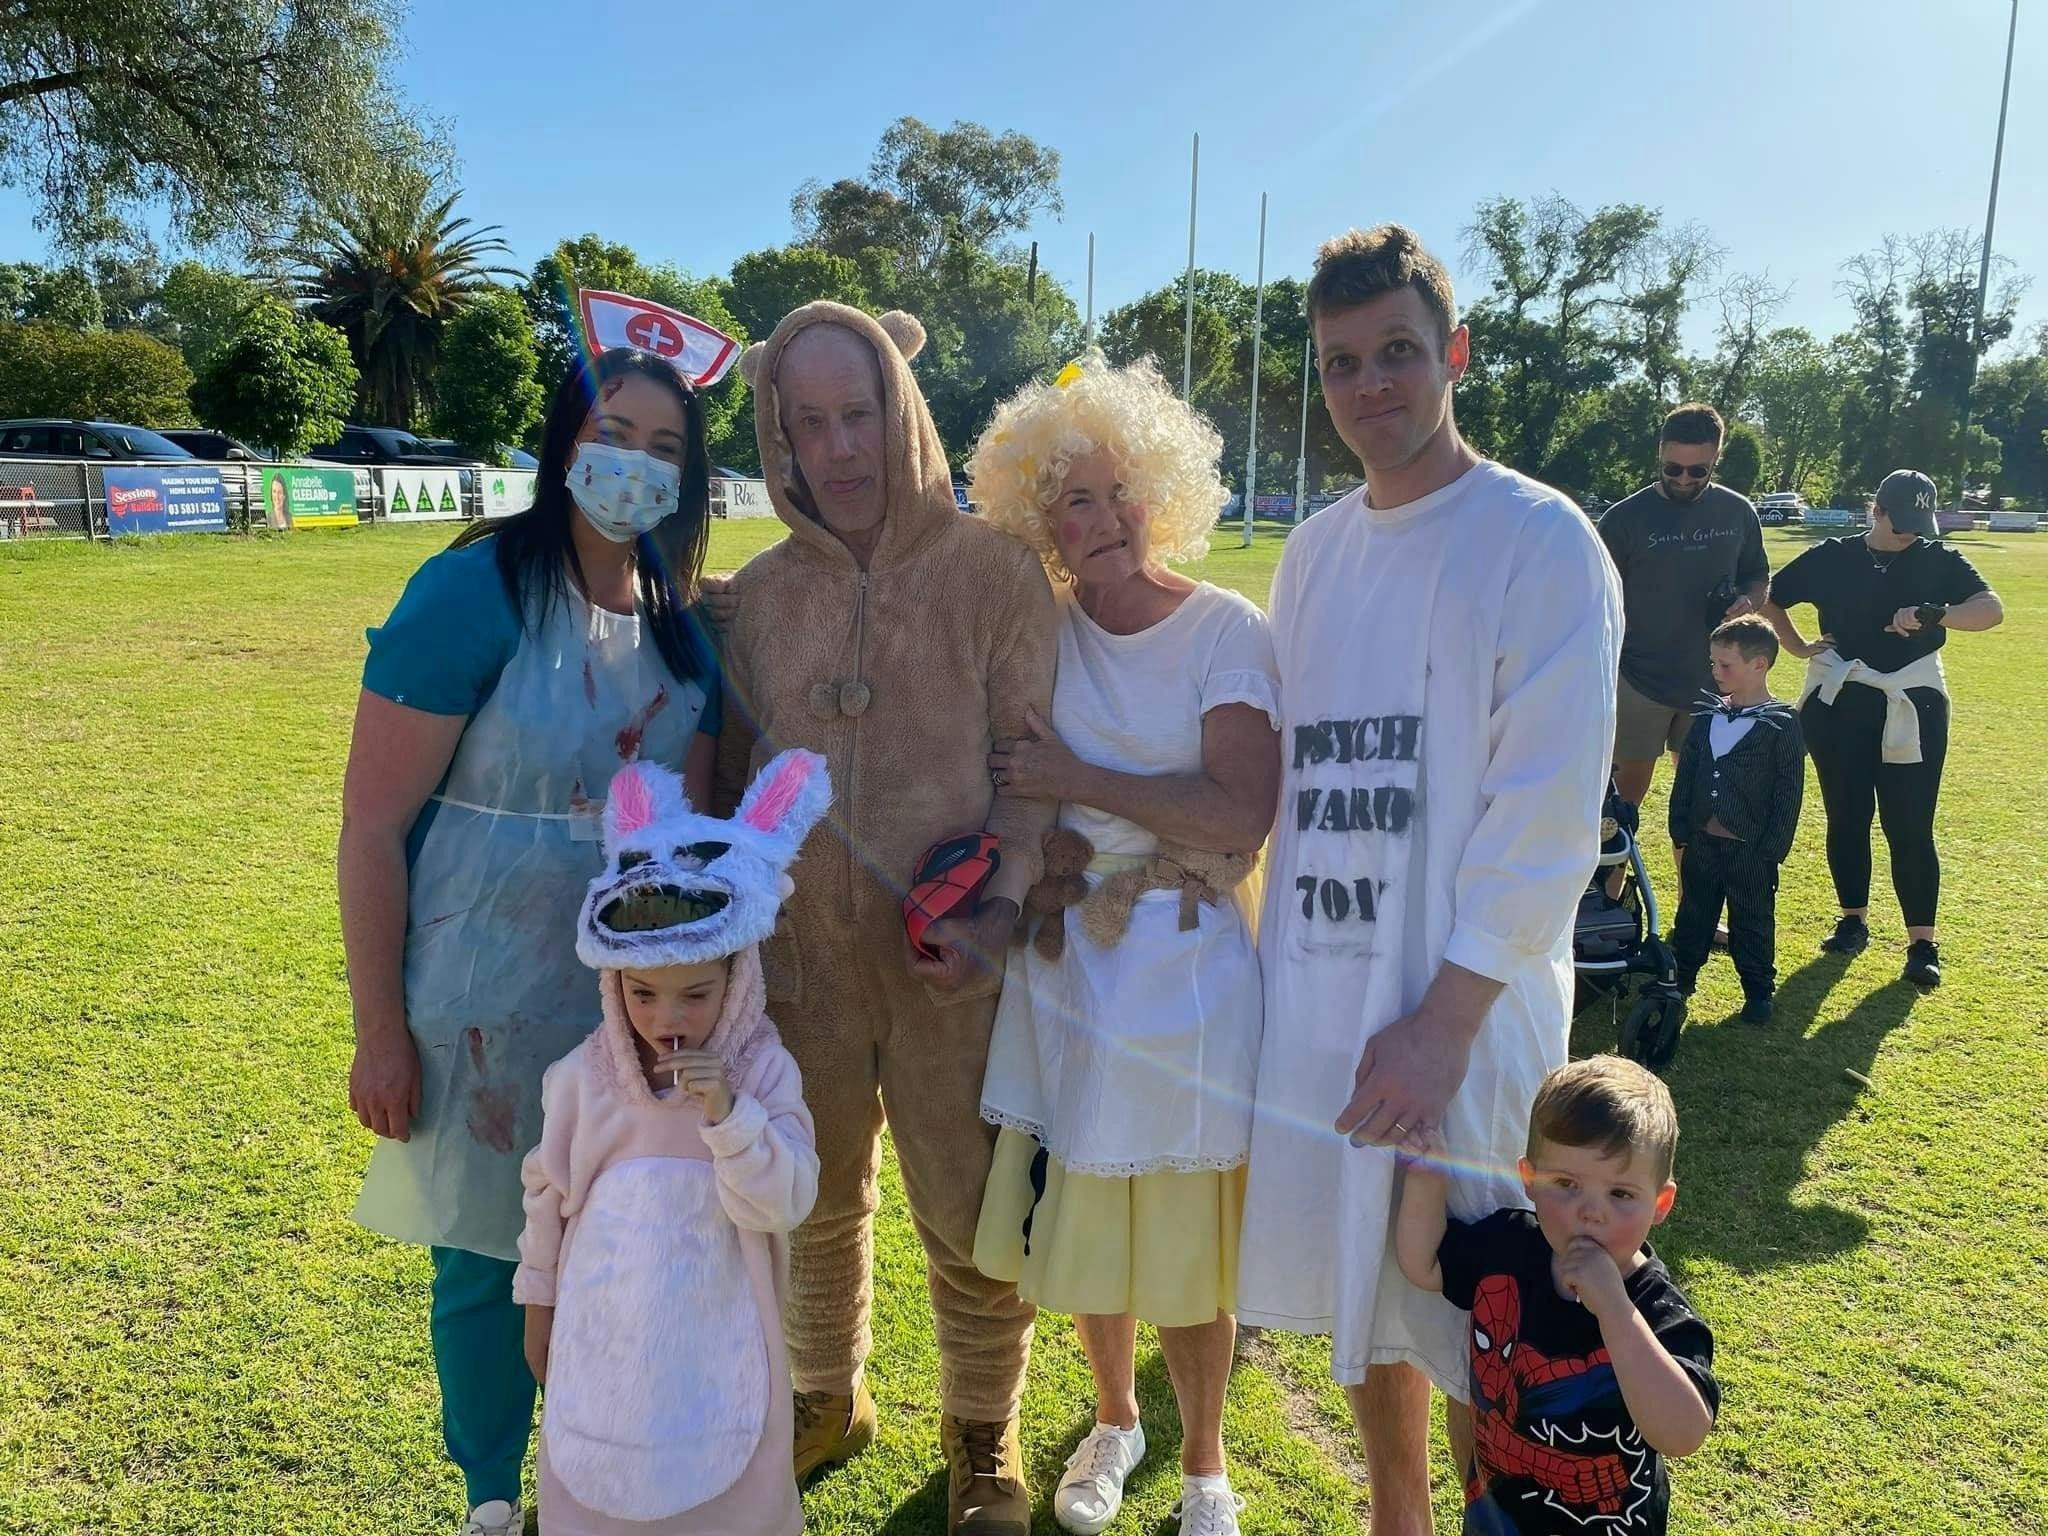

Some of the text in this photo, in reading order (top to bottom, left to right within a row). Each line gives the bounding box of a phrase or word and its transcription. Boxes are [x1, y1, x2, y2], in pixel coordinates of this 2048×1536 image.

[114, 488, 157, 503] Sessions
[293, 488, 328, 501] CLEELAND
[168, 502, 220, 515] 03 5831 5226
[1293, 715, 1423, 769] PSYCH
